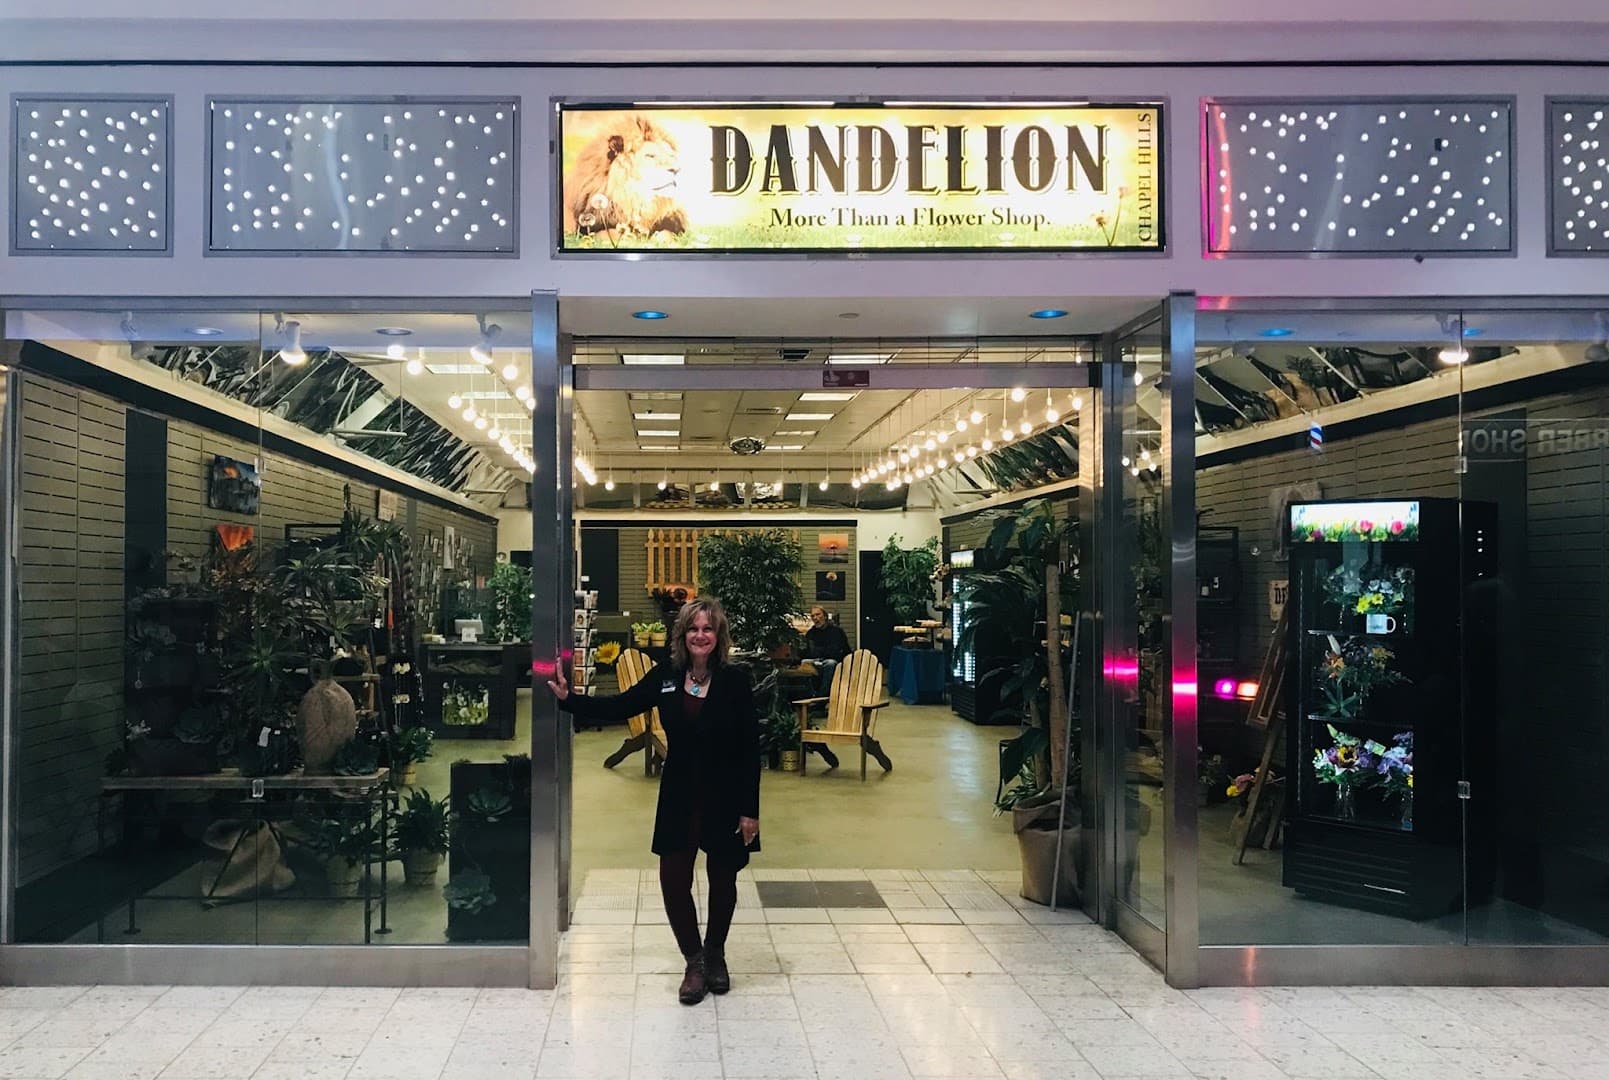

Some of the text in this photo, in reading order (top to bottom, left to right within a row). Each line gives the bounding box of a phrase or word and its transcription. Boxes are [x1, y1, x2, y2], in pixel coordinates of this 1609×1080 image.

[708, 124, 1109, 196] DANDELION
[1137, 113, 1152, 243] CHAPEL HILLS
[770, 206, 1051, 231] More Than a Flower Shop.
